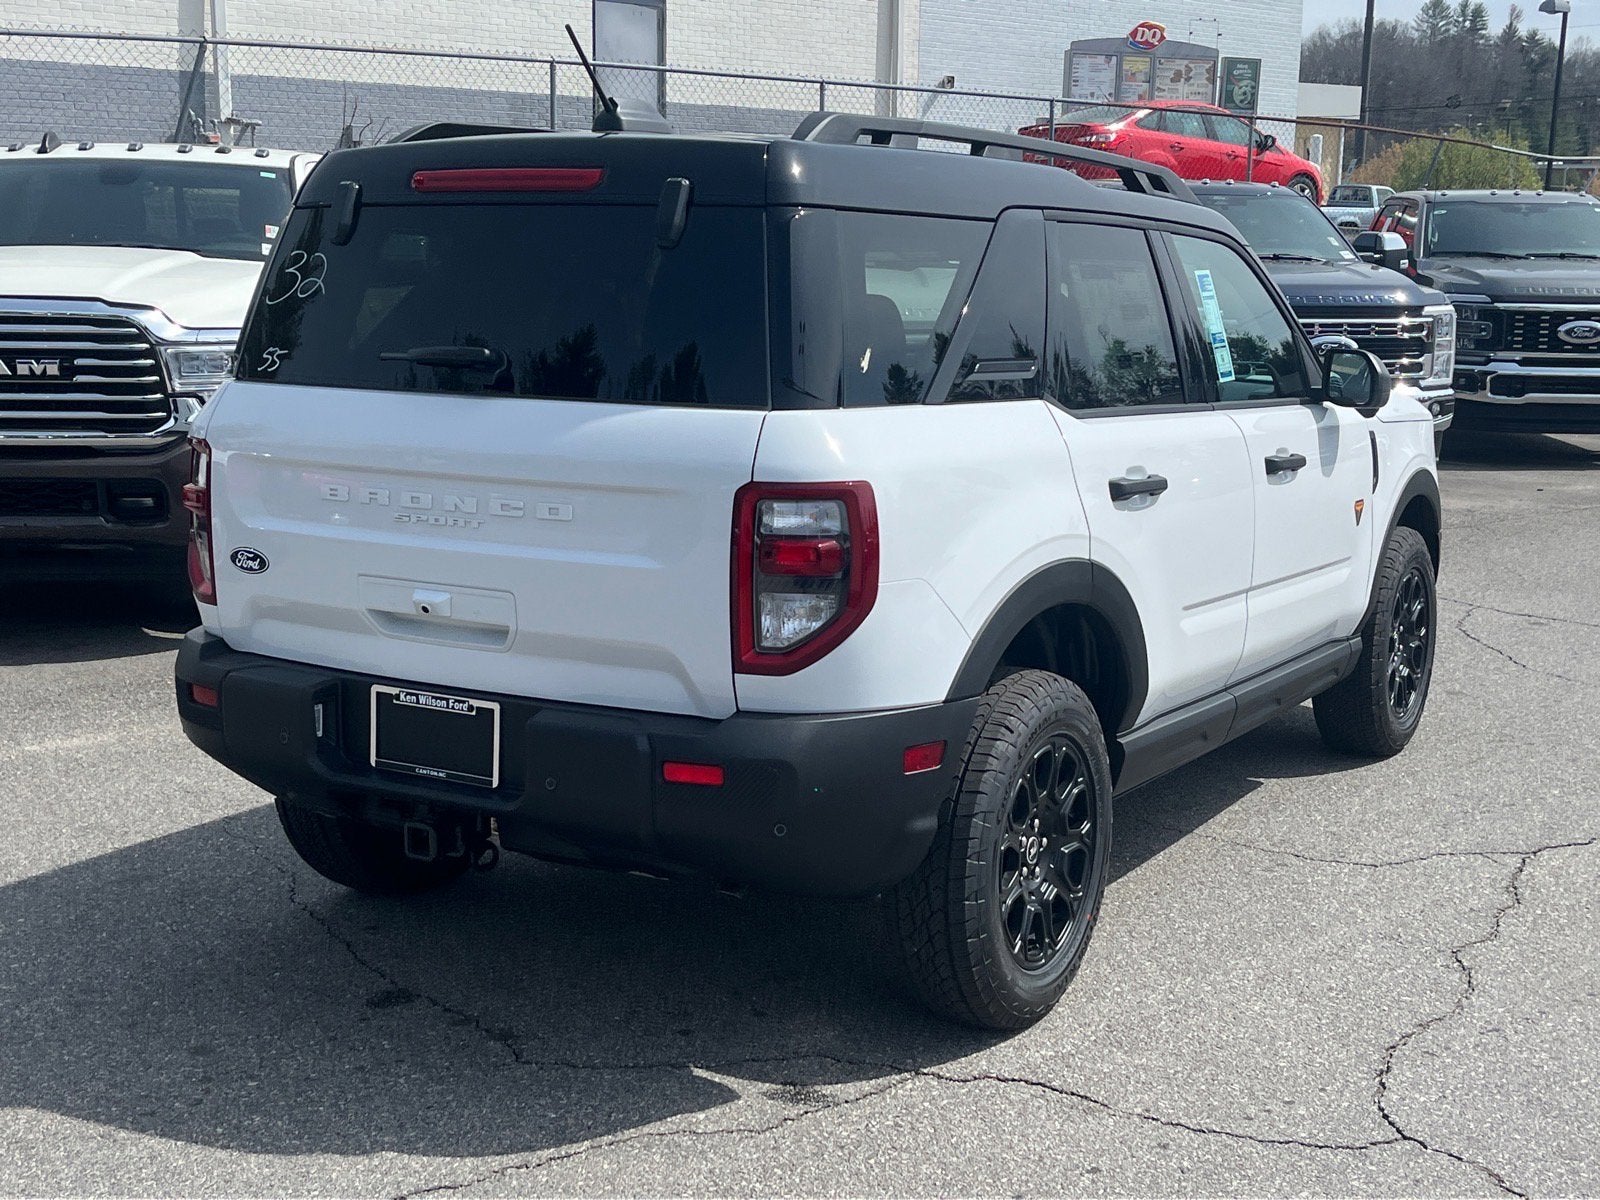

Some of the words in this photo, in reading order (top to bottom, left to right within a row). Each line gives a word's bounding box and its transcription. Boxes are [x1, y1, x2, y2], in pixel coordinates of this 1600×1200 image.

[1134, 27, 1161, 46] DQ
[265, 250, 328, 306] 32
[321, 482, 574, 522] BRONCO
[392, 511, 486, 530] SPORT
[399, 691, 417, 703] Ken
[418, 694, 447, 708] Wilson
[448, 698, 469, 711] Ford
